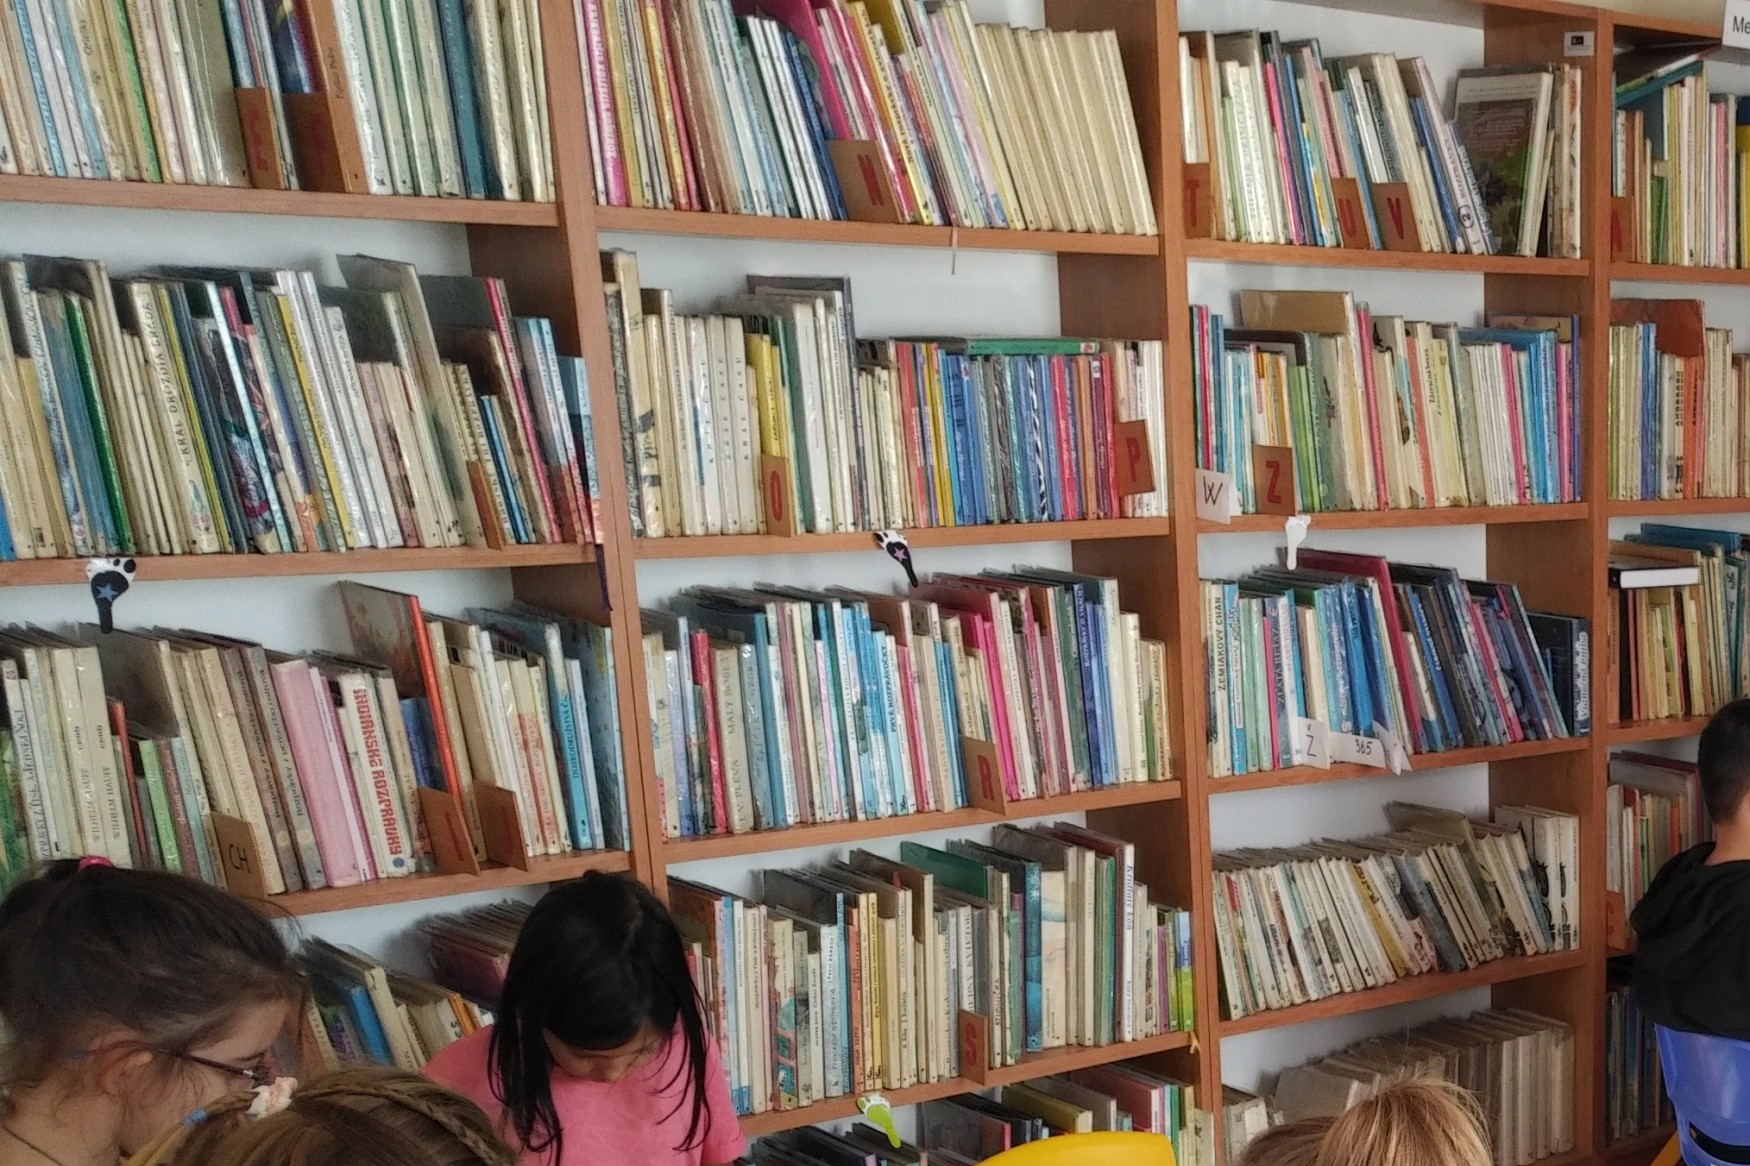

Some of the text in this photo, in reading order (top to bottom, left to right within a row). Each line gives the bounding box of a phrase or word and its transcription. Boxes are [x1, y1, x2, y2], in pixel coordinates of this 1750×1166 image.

[1186, 179, 1200, 227] T
[1337, 197, 1356, 236] U
[1386, 197, 1404, 240] V
[155, 353, 178, 412] DROZDIA
[1126, 437, 1141, 483] P
[1202, 480, 1224, 504] W
[1265, 461, 1282, 504] Z
[879, 645, 895, 709] ROZPRÁVOČKY
[1215, 629, 1227, 691] ZEMIAKOVÝ
[723, 701, 736, 735] MALÝ
[1303, 722, 1319, 758] Ž
[1355, 738, 1373, 757] 365
[730, 759, 743, 798] PLEVA
[976, 754, 994, 801] R
[228, 844, 251, 874] CH
[965, 1022, 978, 1067] S
